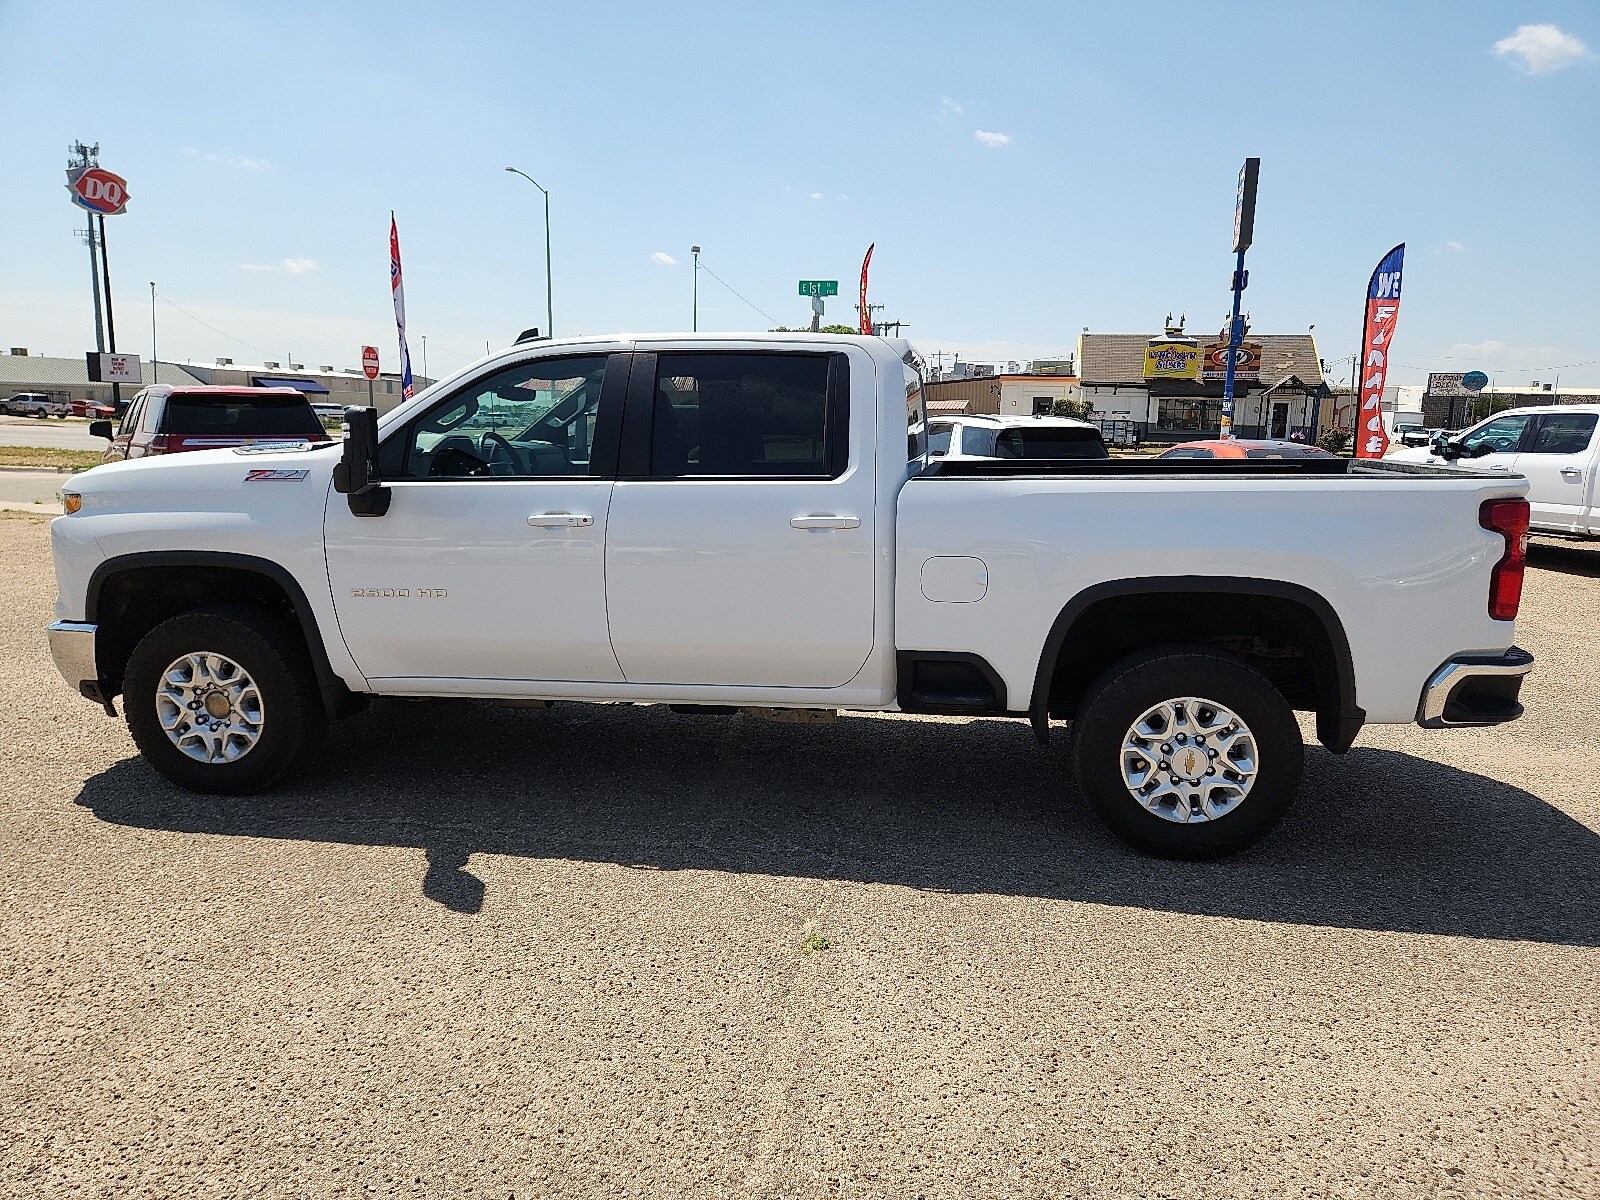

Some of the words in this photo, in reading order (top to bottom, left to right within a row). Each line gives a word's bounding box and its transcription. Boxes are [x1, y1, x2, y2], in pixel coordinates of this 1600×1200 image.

[85, 176, 121, 207] DQ
[802, 283, 807, 293] E
[1377, 271, 1400, 298] WE
[244, 469, 311, 482] Z71
[350, 588, 410, 598] 2500
[417, 588, 448, 598] HD
